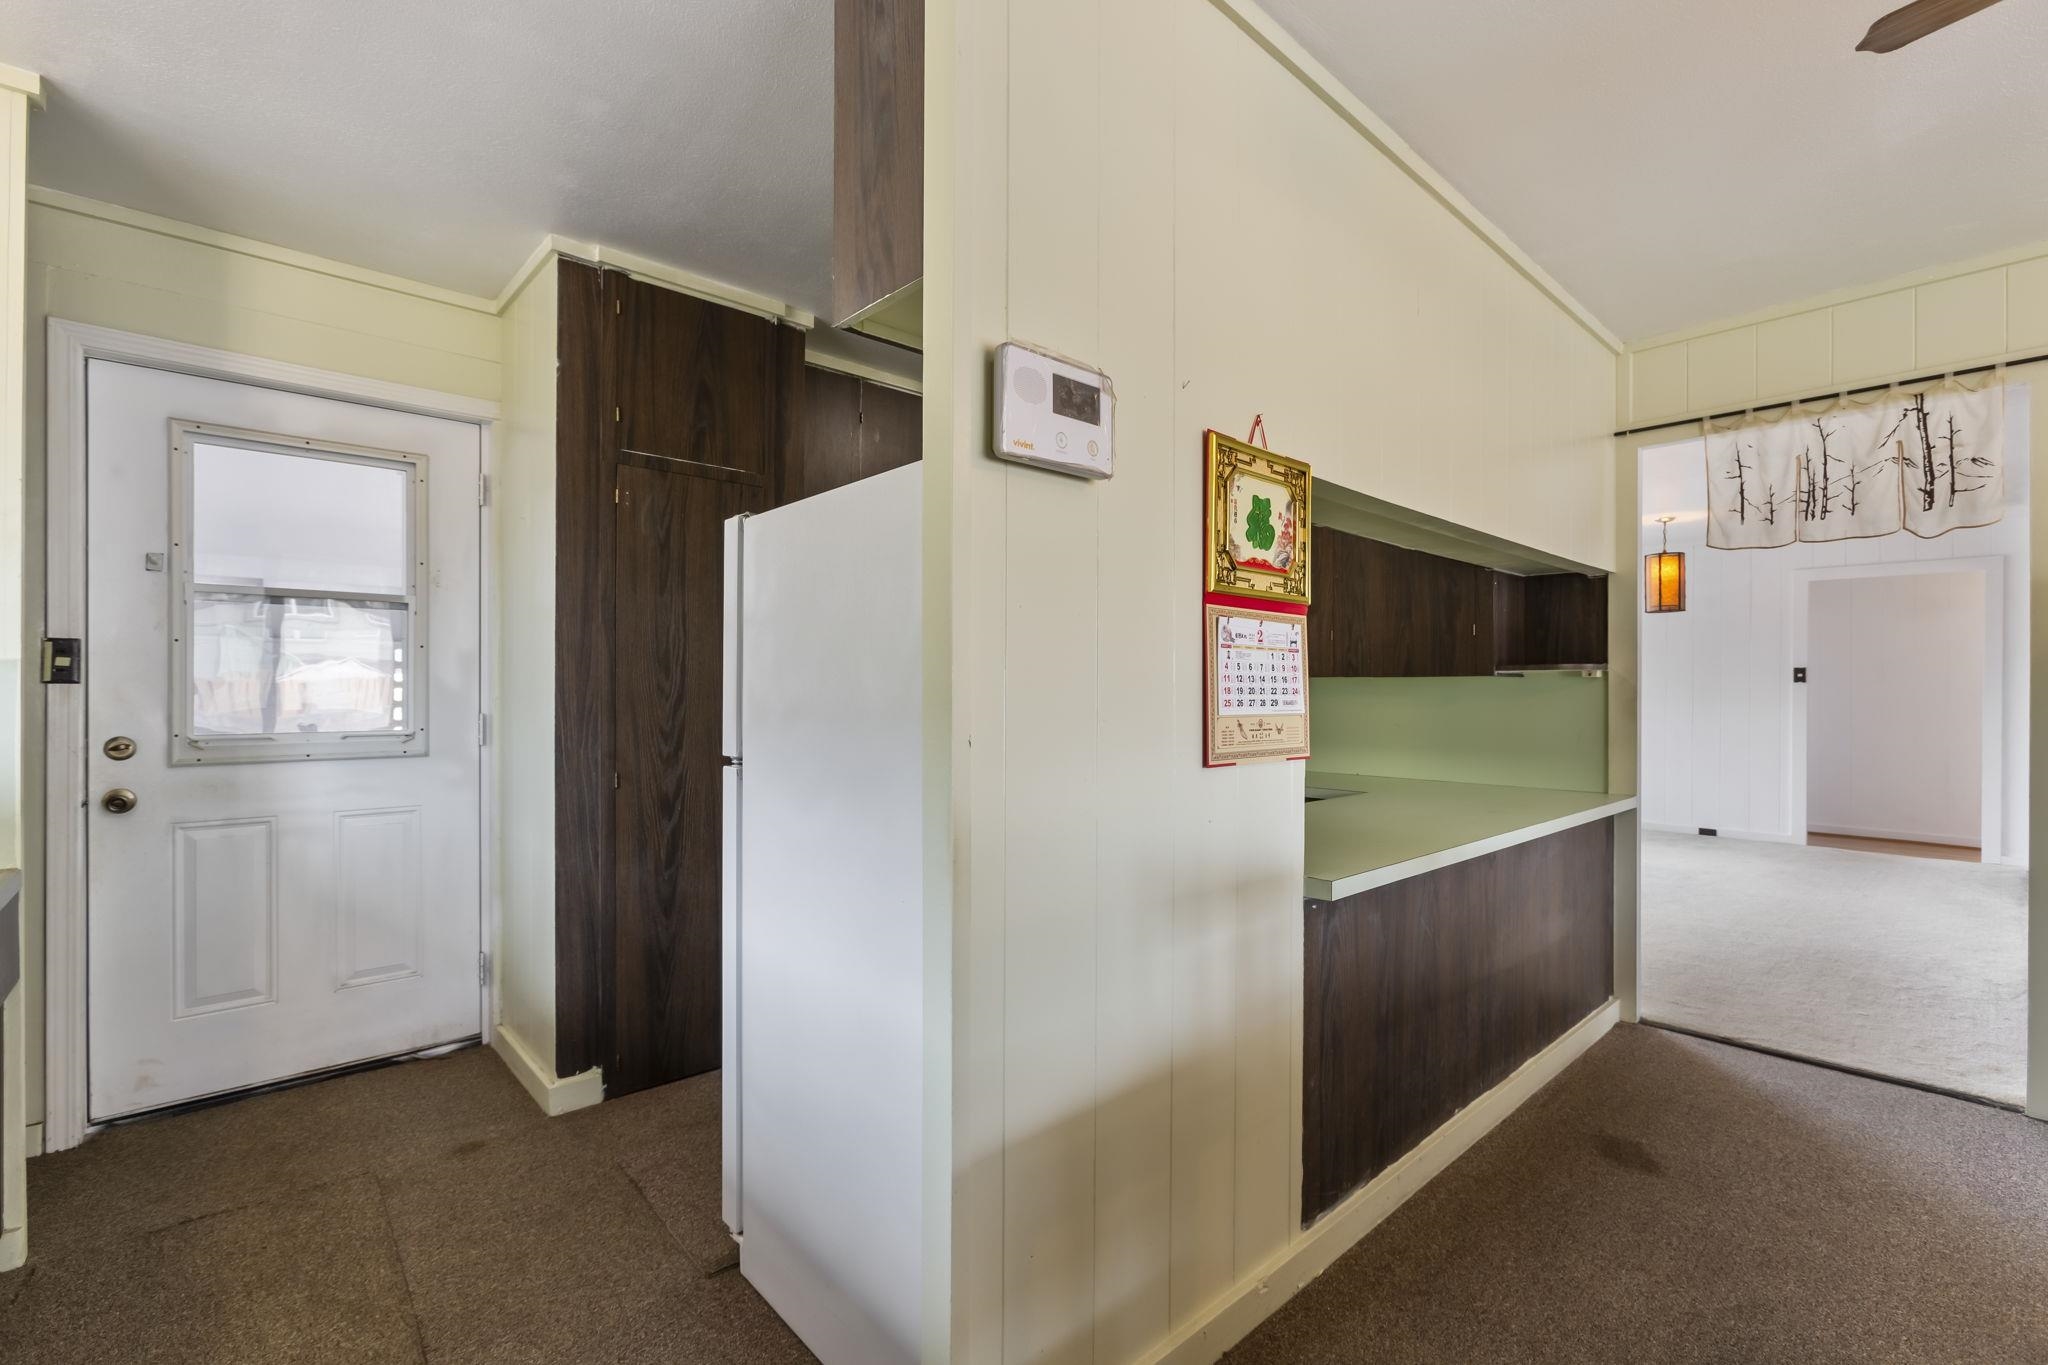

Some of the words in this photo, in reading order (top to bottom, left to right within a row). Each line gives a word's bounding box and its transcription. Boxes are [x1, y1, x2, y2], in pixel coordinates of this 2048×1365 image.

[1257, 630, 1264, 642] 2
[1224, 675, 1230, 683] 11
[1236, 675, 1243, 683] 12
[1248, 675, 1255, 683] 13
[1224, 687, 1231, 695] 18
[1236, 687, 1244, 695] 19
[1271, 699, 1279, 707] 29
